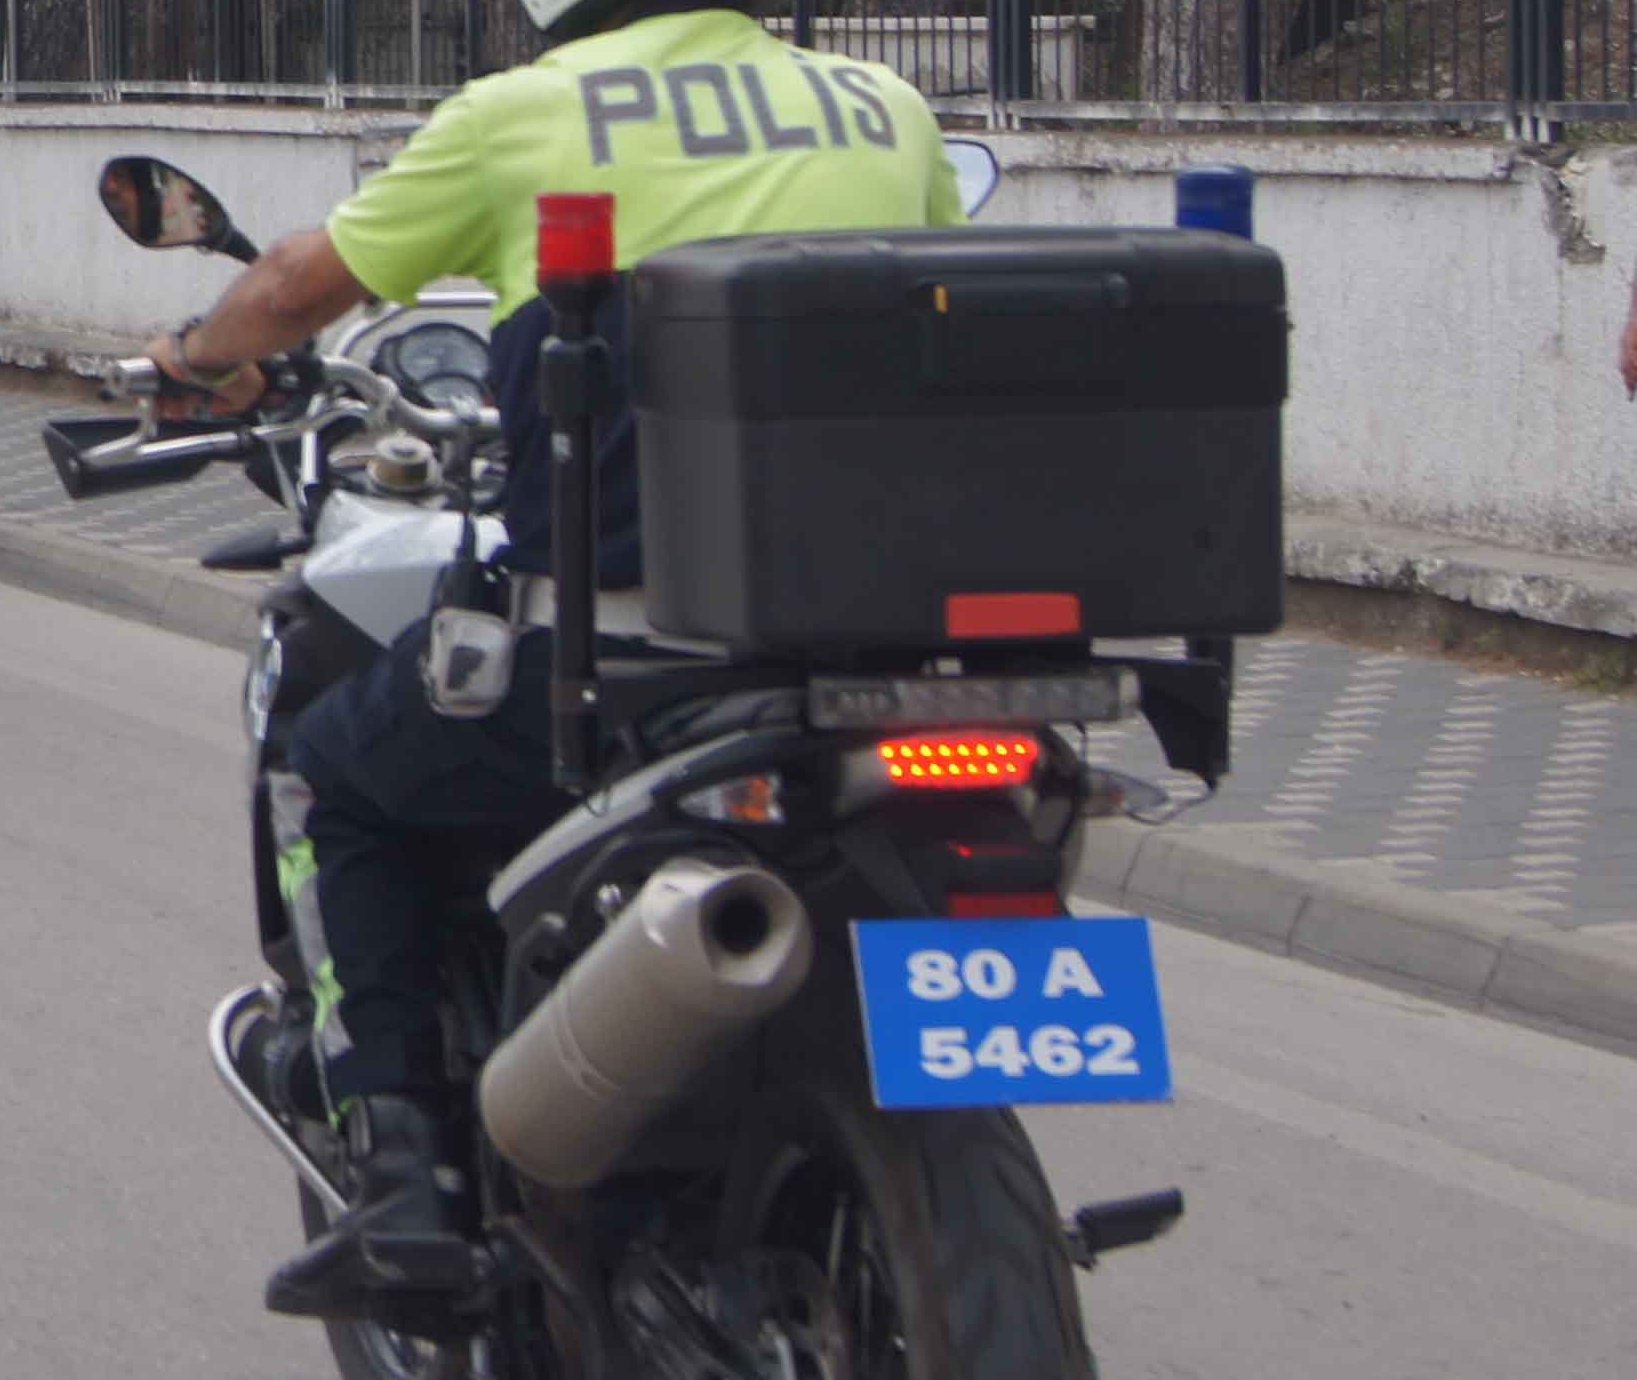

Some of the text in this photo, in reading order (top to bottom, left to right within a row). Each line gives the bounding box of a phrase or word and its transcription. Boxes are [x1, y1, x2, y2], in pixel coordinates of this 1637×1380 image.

[577, 50, 897, 167] POLİS
[906, 946, 1104, 1001] 80 A
[919, 1024, 1141, 1080] 5462
